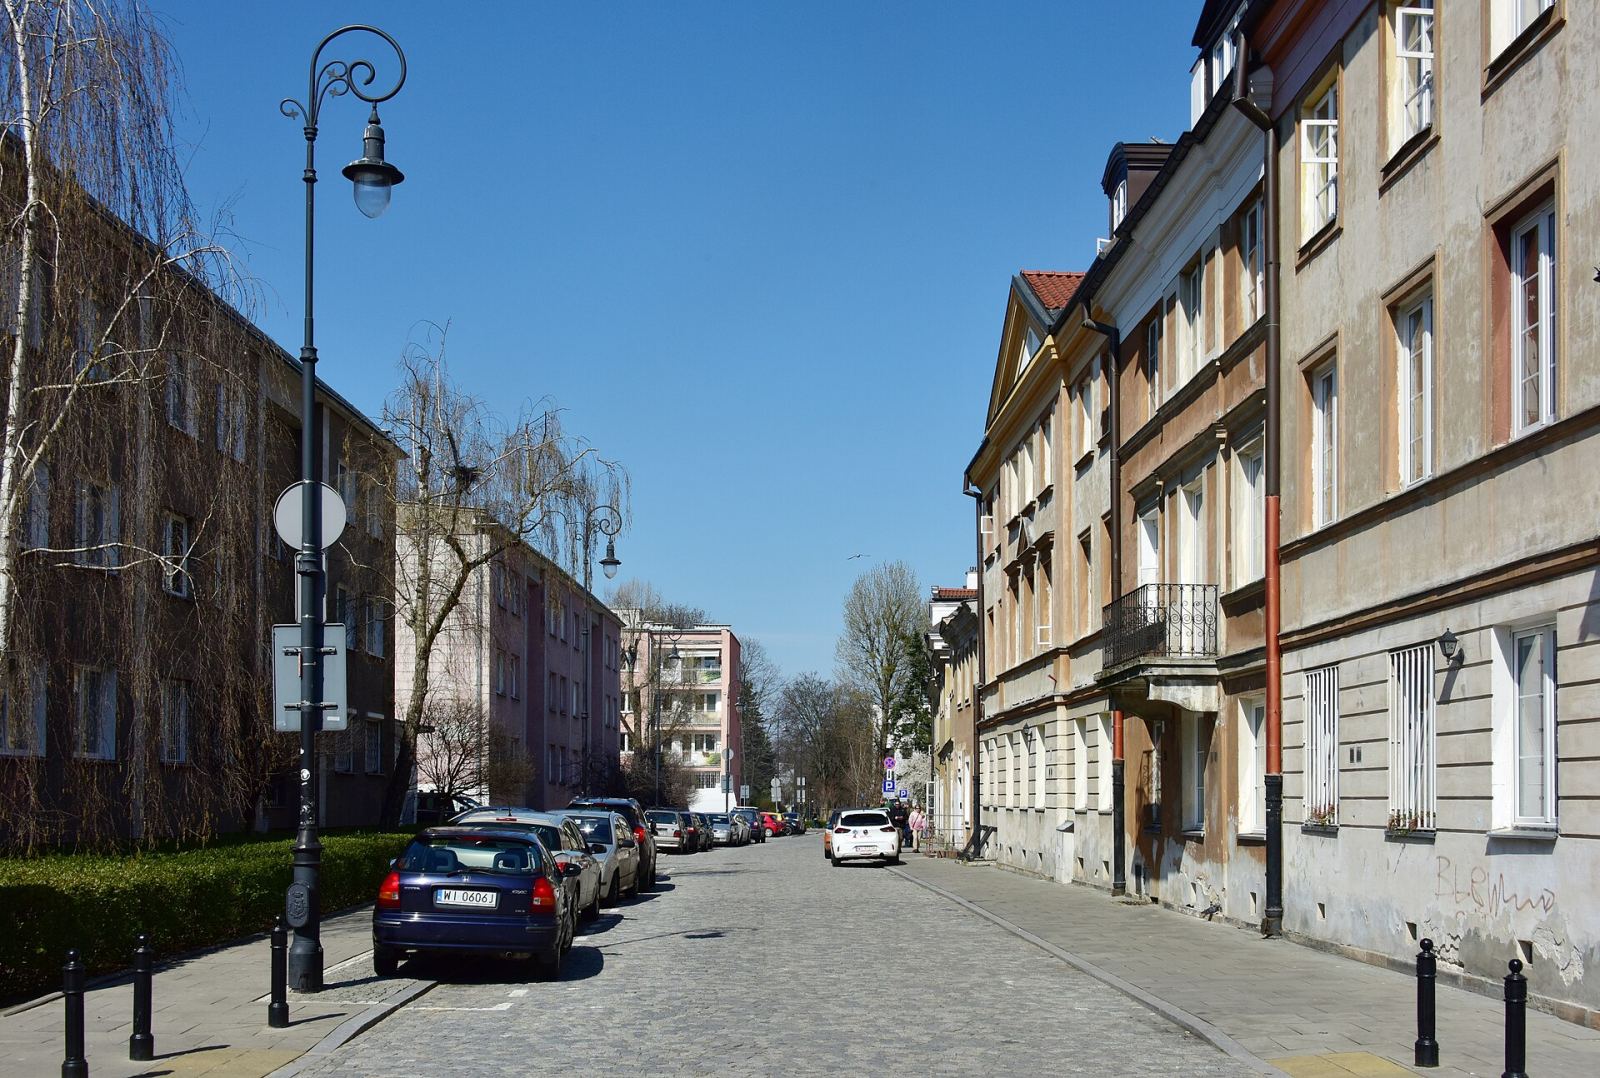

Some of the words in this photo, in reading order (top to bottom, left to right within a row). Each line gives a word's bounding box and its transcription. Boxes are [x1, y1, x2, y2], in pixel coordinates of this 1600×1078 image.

[885, 782, 893, 791] P
[444, 890, 456, 901] WI
[462, 891, 494, 904] 0606J
